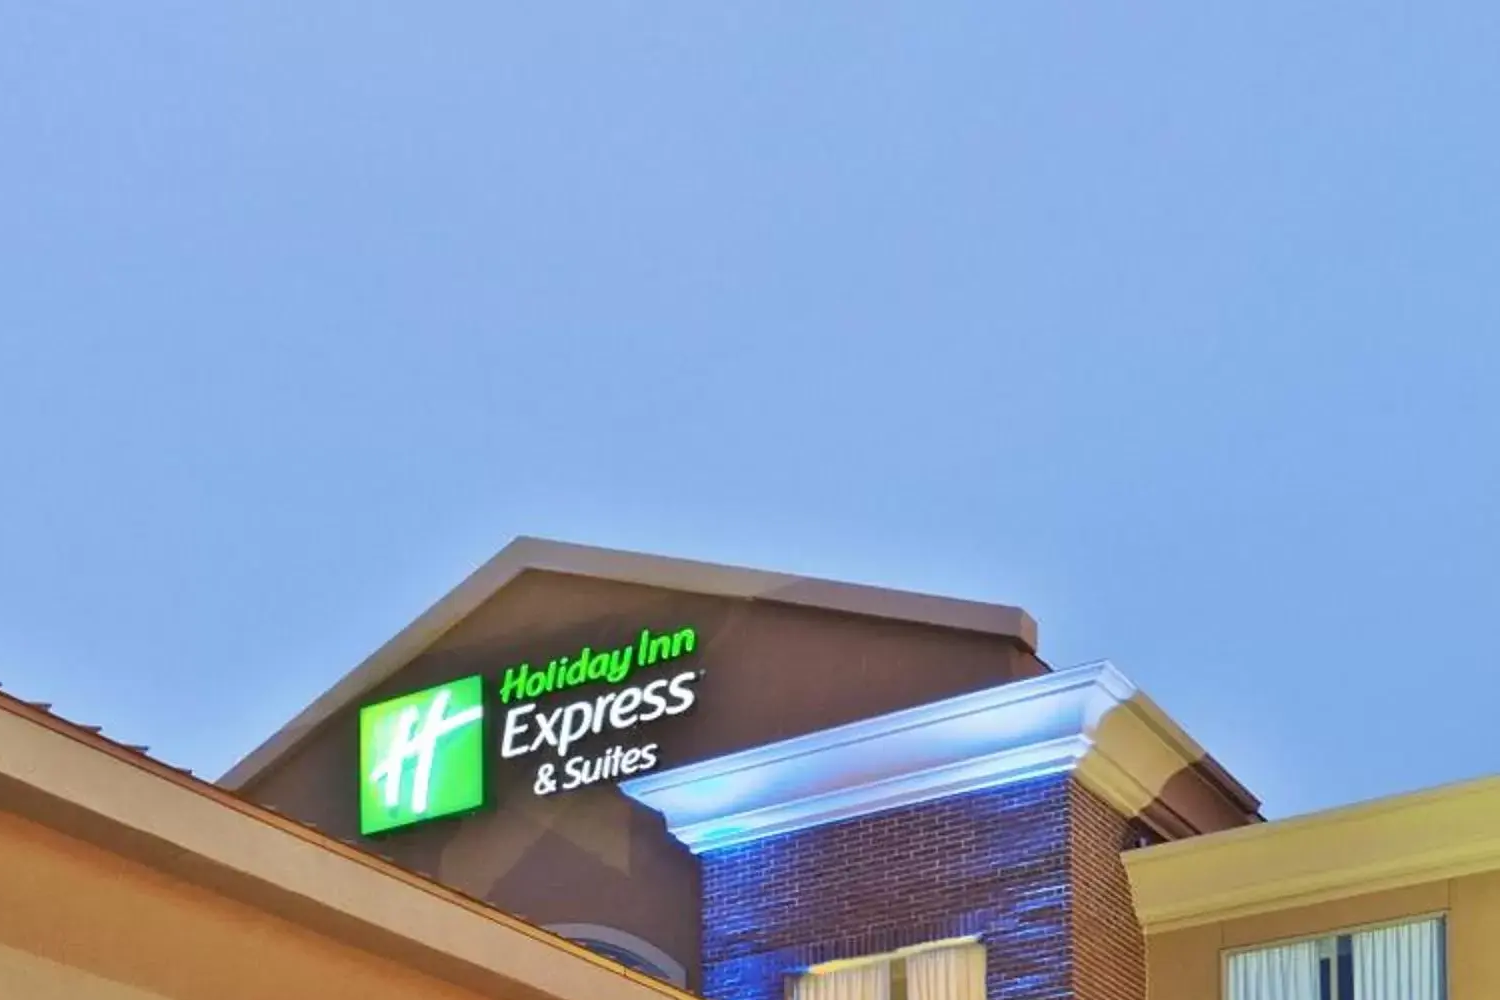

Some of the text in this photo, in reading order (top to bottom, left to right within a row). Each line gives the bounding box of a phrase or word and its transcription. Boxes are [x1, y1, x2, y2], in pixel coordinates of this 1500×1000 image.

[500, 627, 696, 704] Holiday Inn
[501, 671, 697, 759] Express
[533, 742, 658, 796] & Suites
